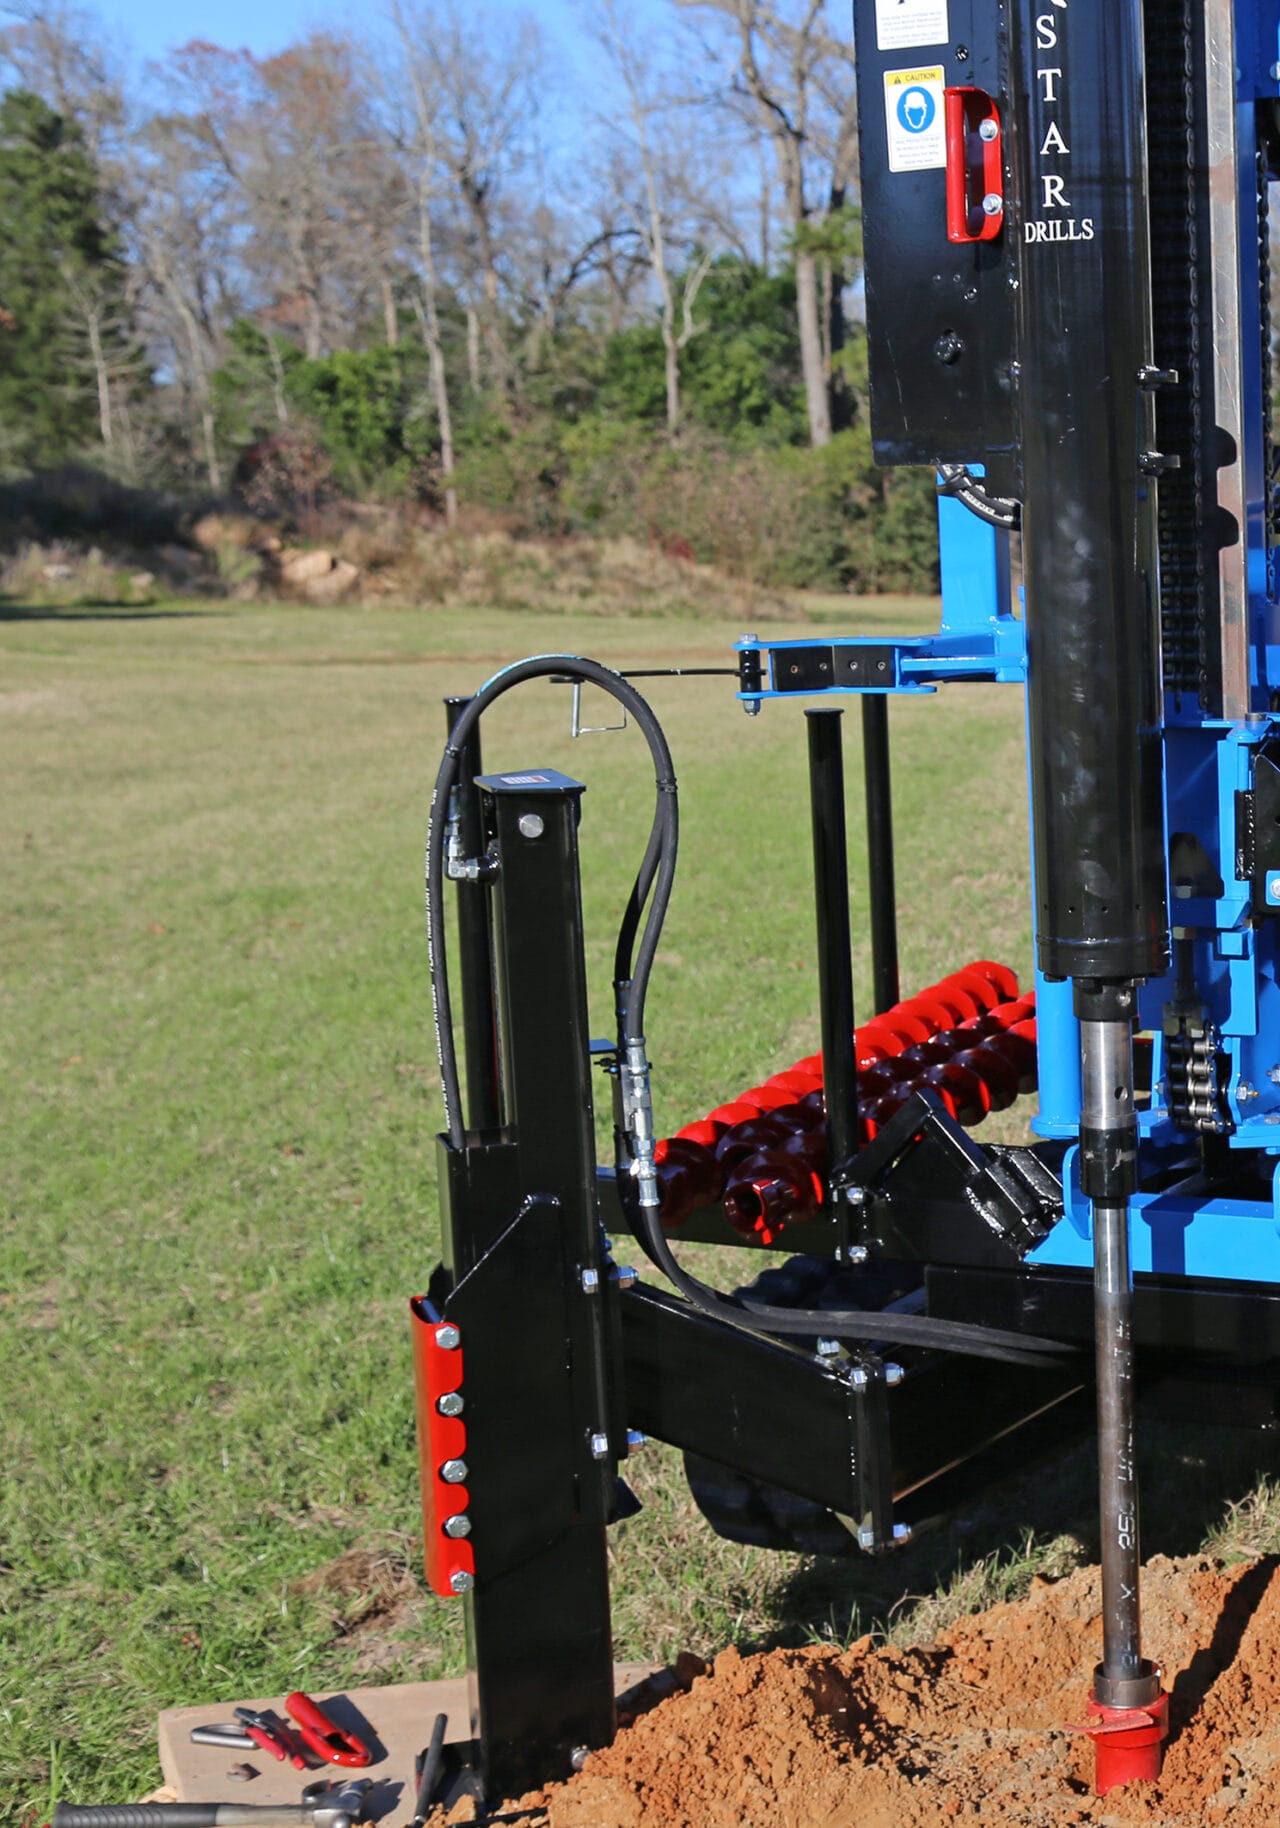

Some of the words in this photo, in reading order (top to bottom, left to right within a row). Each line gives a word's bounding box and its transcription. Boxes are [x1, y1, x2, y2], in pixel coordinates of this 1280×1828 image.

[905, 72, 936, 82] CAUTION
[1035, 0, 1071, 208] STAR
[1024, 218, 1094, 243] DRILLS
